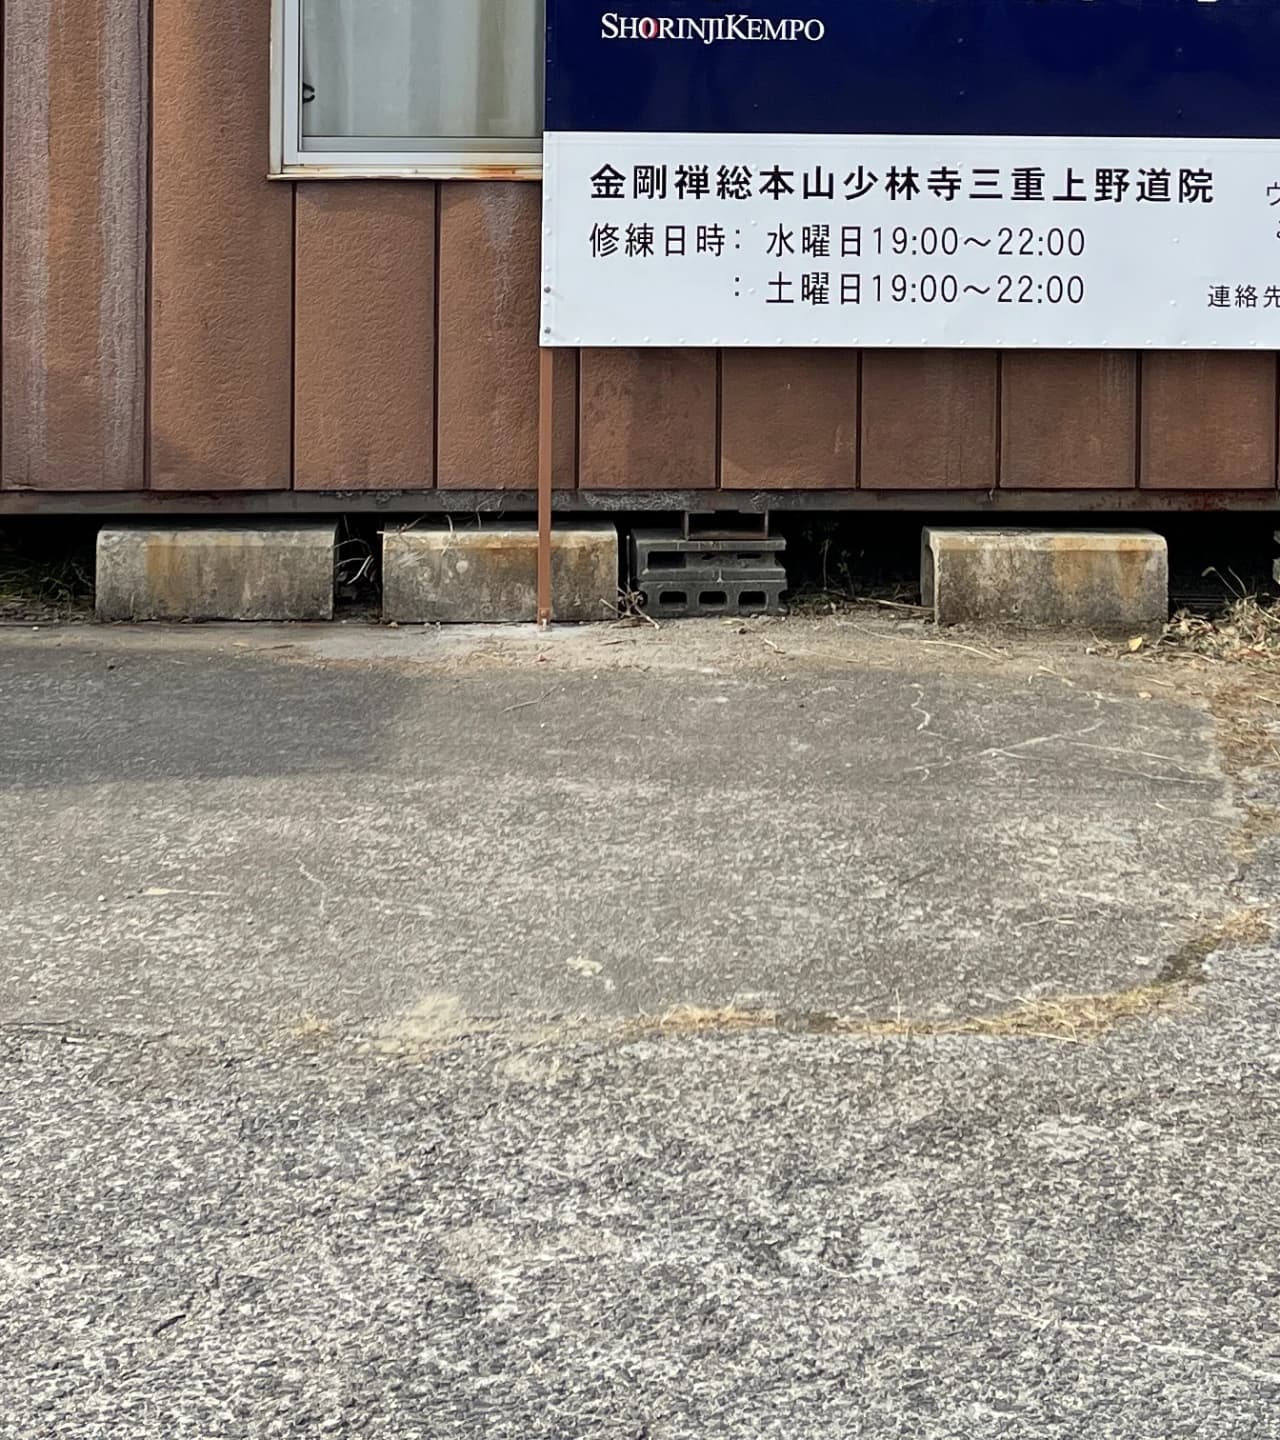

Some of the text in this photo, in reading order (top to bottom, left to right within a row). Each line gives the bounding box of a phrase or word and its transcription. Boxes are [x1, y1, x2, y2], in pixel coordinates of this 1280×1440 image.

[601, 12, 825, 44] SHORINJIKEMPO
[589, 162, 1215, 205] 金剛禅総本山少林寺三重上野道院
